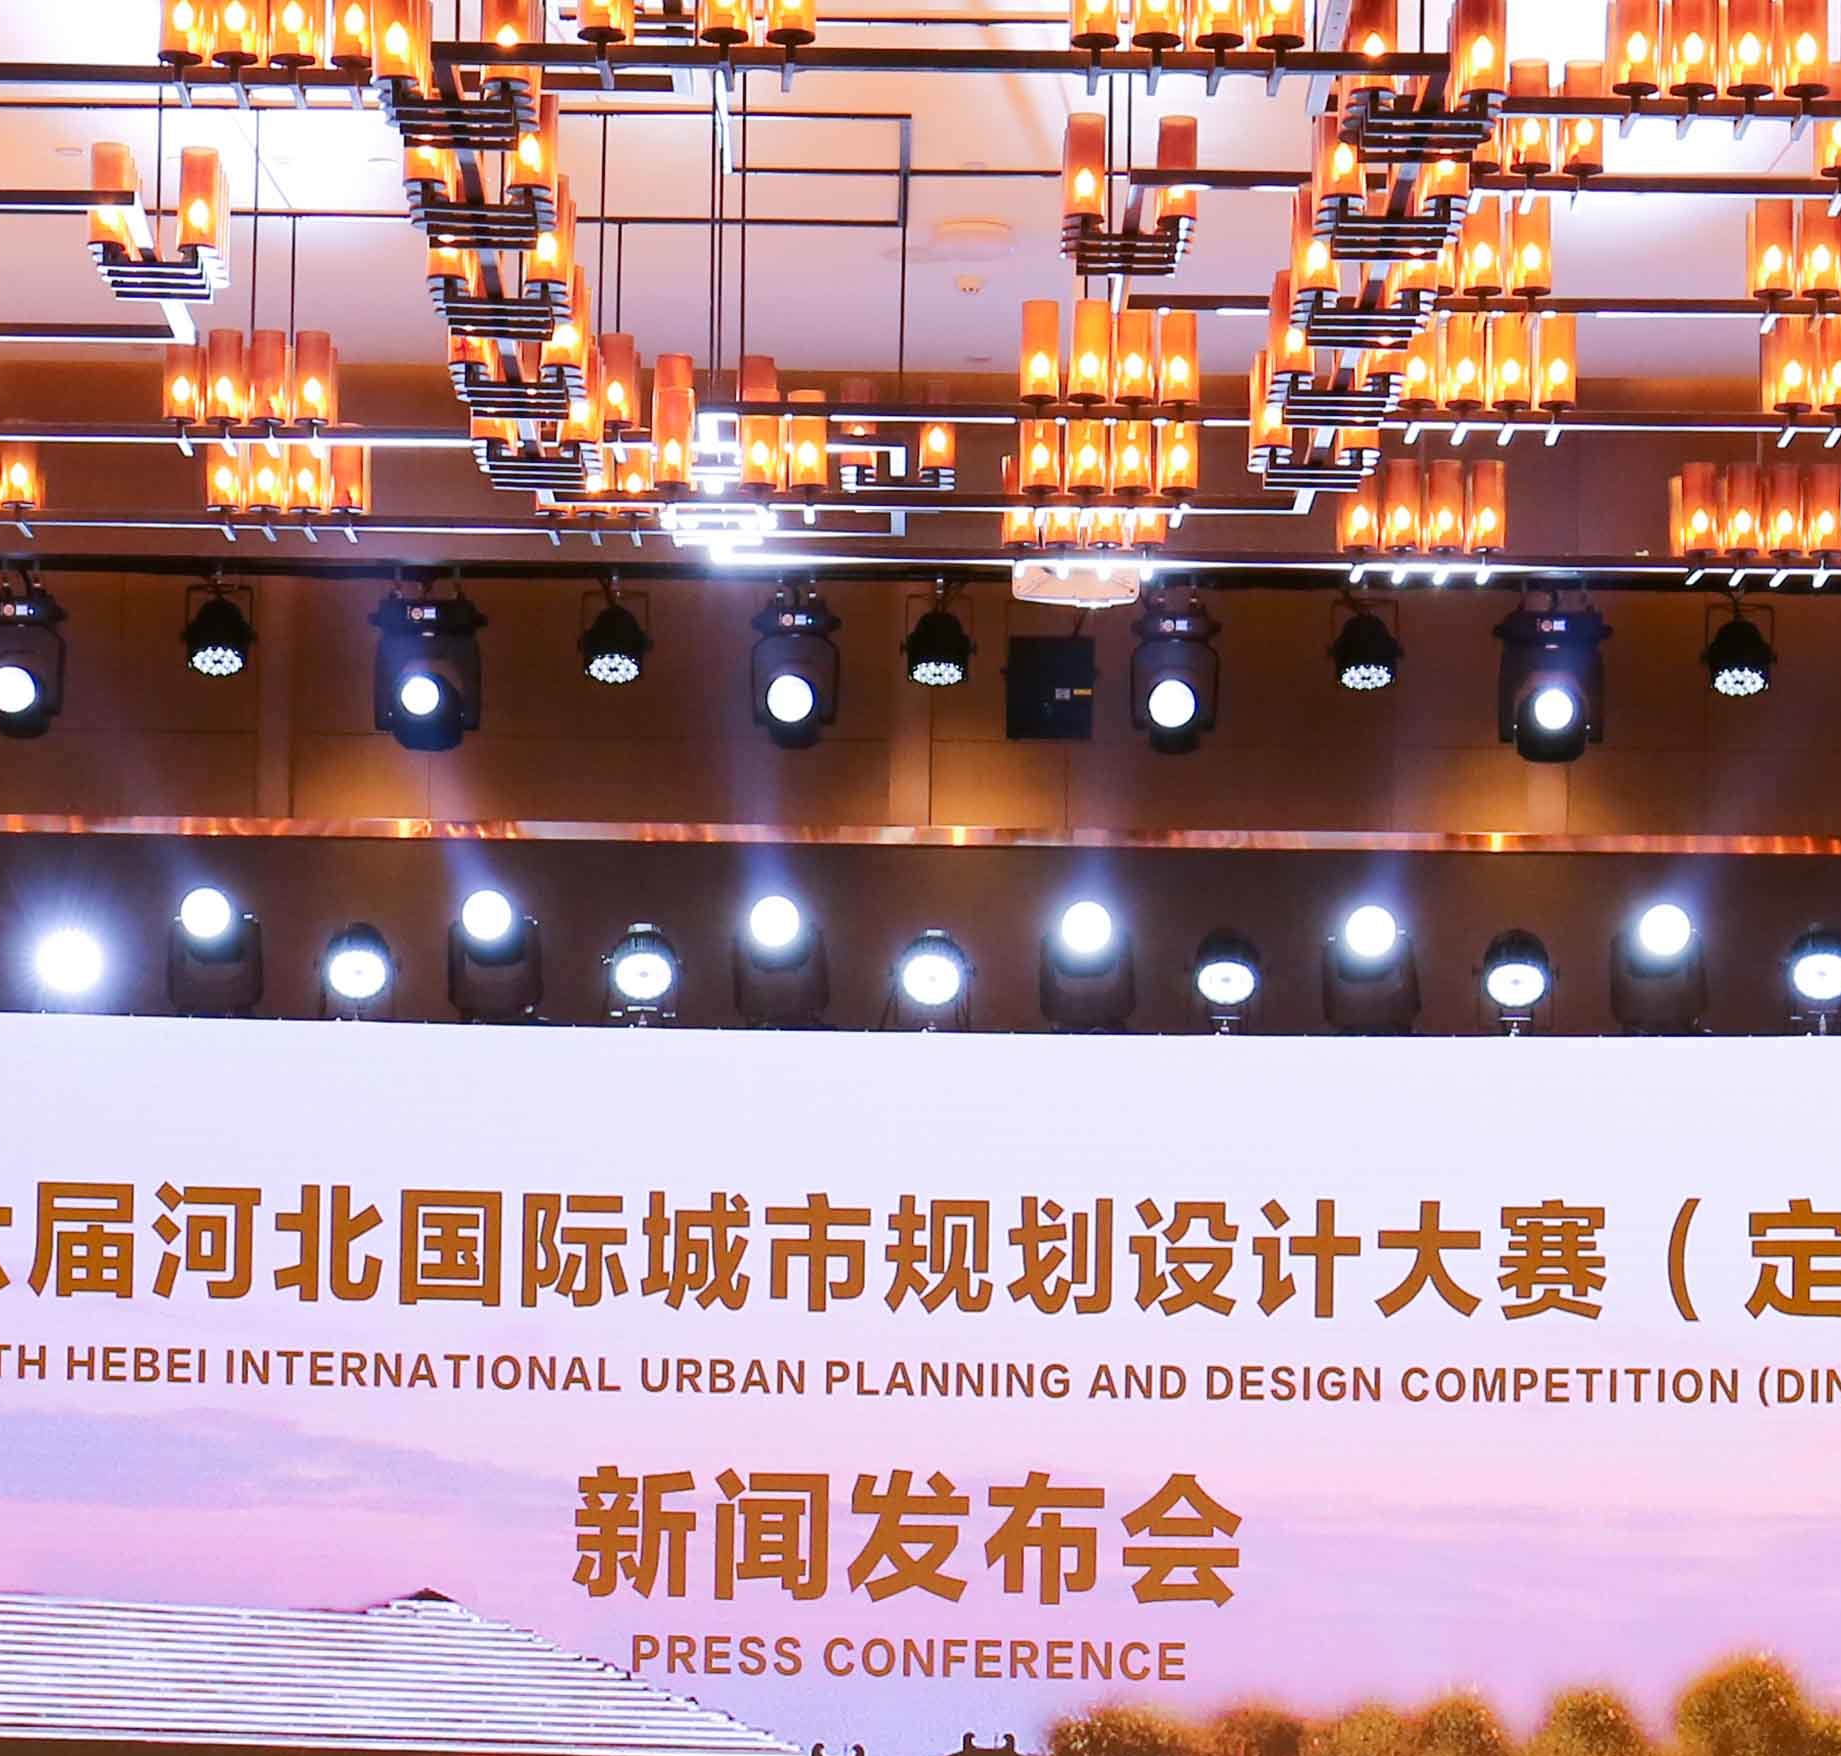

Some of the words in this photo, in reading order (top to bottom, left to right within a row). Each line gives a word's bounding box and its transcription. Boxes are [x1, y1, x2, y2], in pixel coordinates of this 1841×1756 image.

[68, 1345, 208, 1385] HEBEI
[227, 1349, 623, 1394] INTERNATIONAL
[641, 1357, 807, 1396] URBAN
[827, 1360, 1072, 1401] PLANNING
[1090, 1363, 1189, 1402] AND
[1207, 1364, 1383, 1404] DESIGN
[1402, 1366, 1741, 1405] COMPETITION
[573, 1464, 1245, 1607] 新闻发布会
[630, 1634, 804, 1677] PRESS
[825, 1637, 1188, 1684] CONFERENCE
